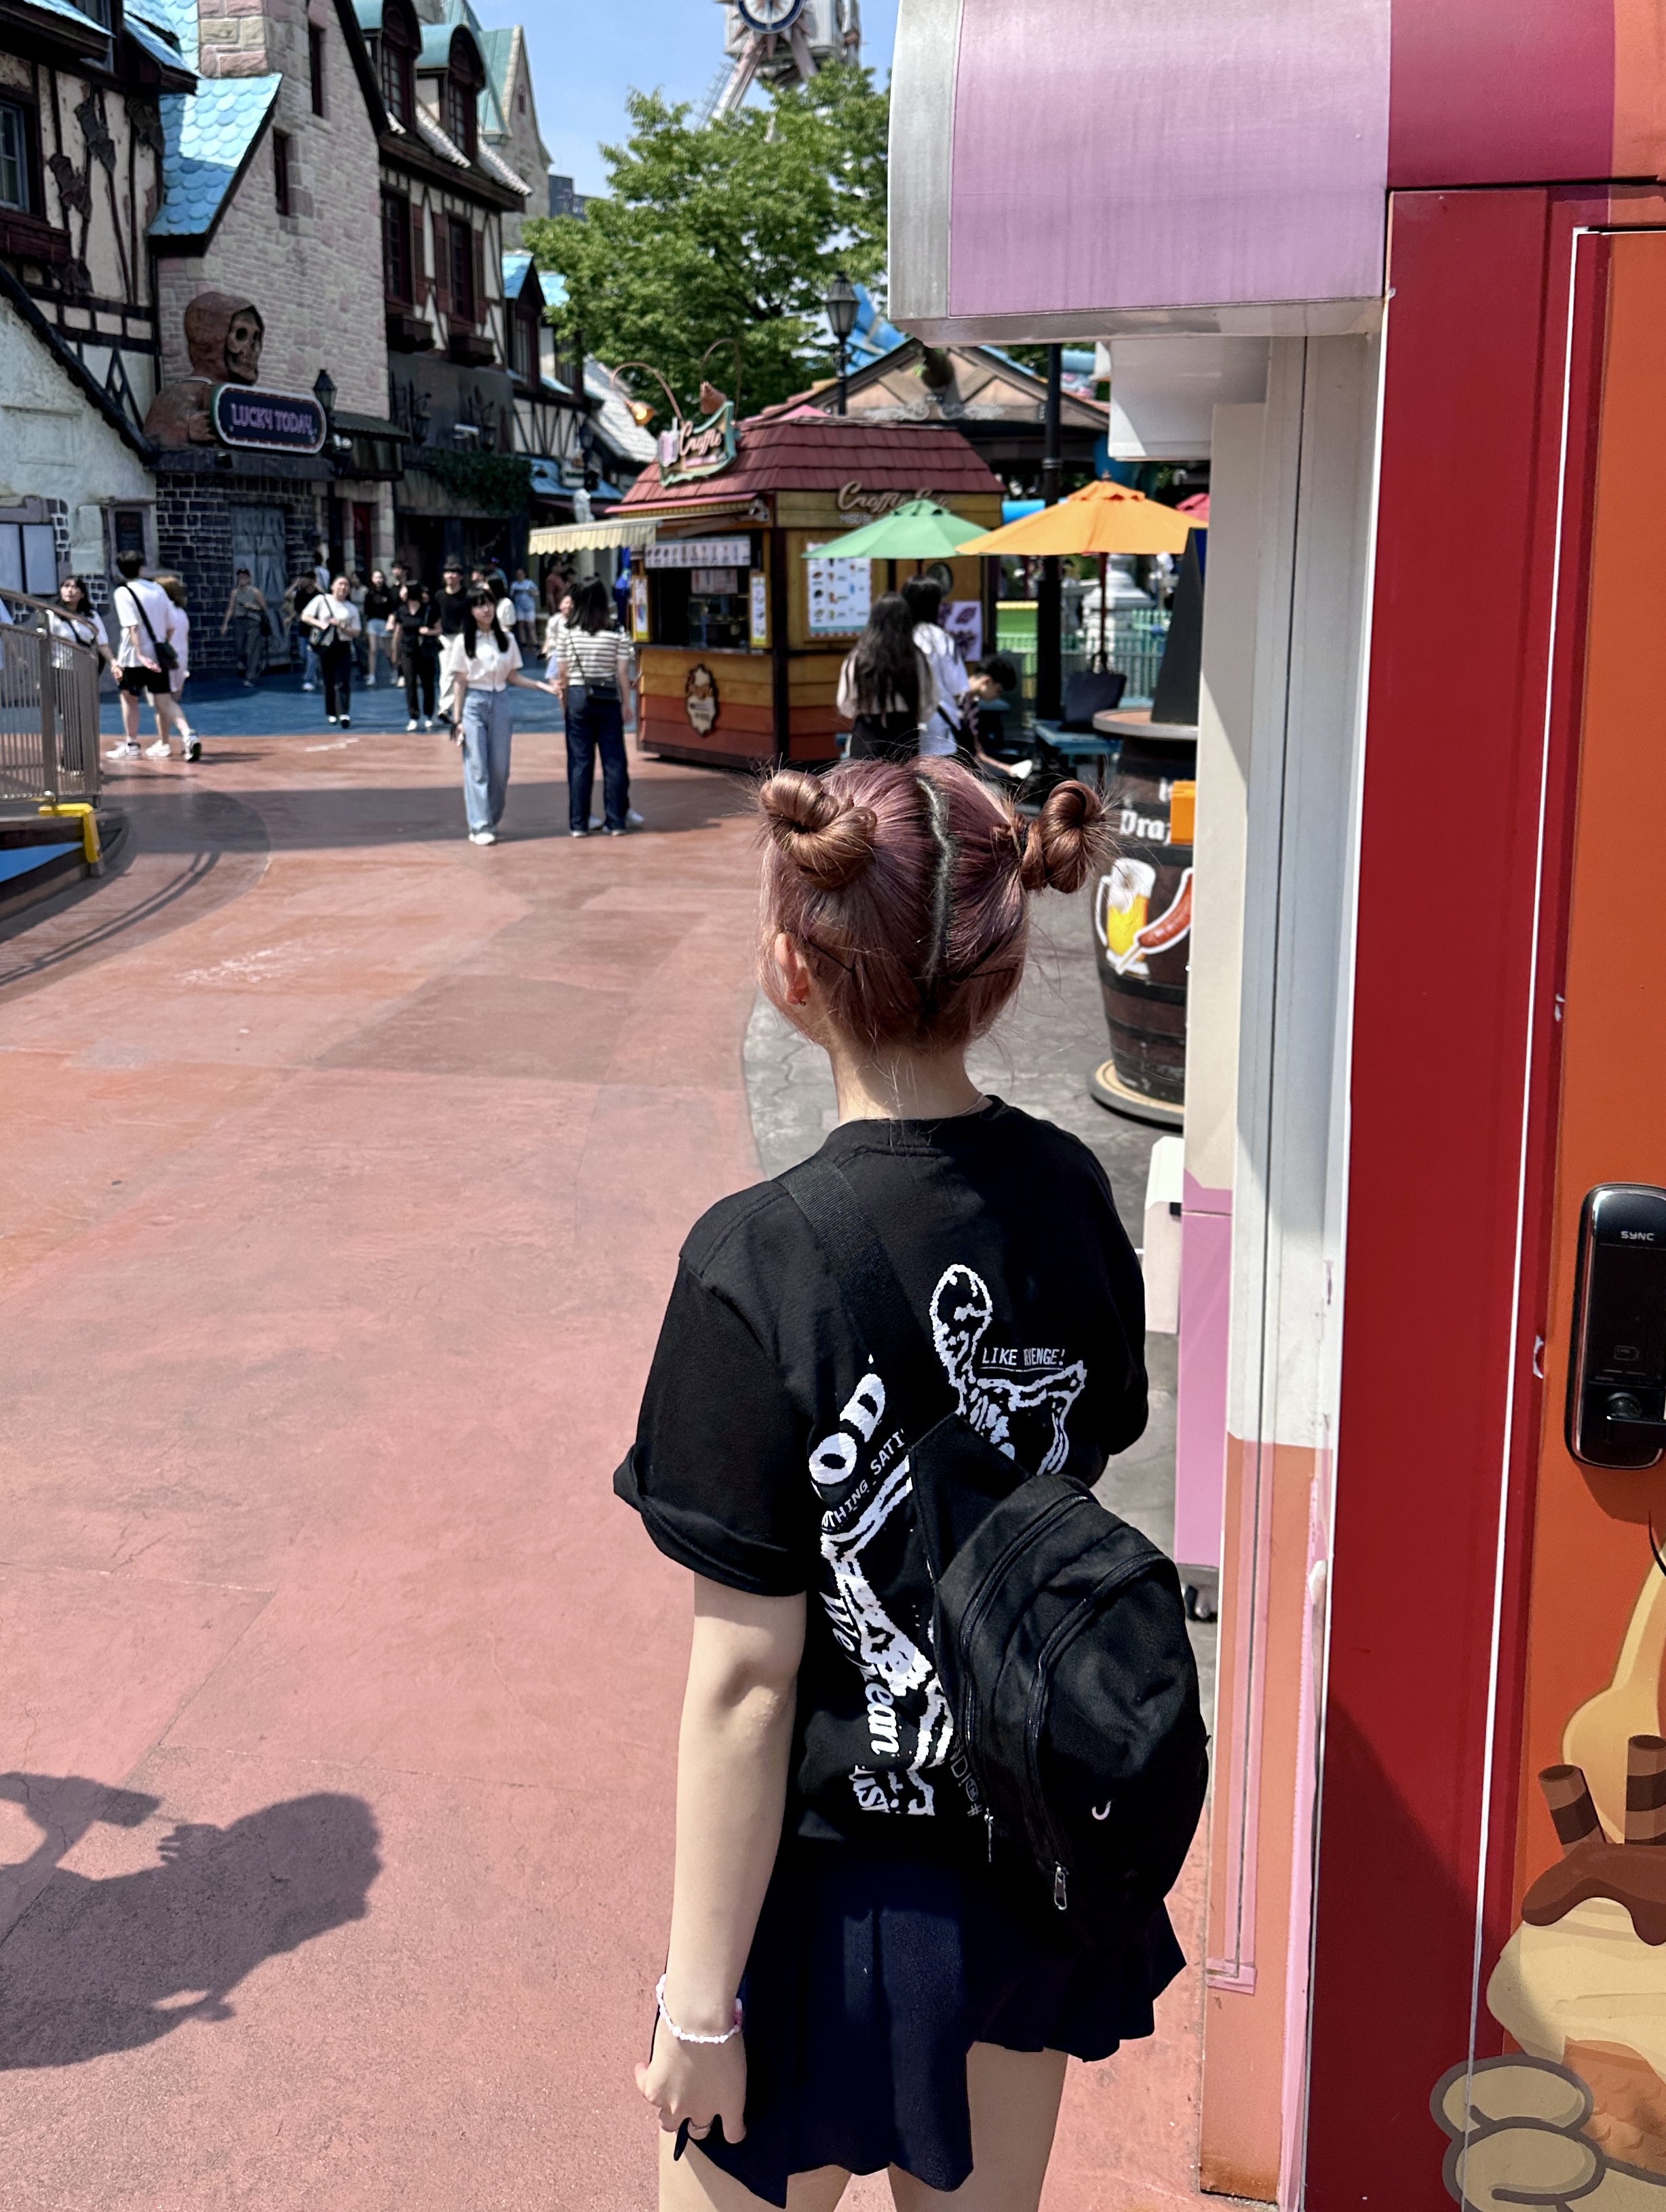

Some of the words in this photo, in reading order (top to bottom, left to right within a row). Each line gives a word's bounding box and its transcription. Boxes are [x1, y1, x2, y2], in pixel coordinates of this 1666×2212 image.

[231, 402, 273, 430] LUCKY
[274, 410, 313, 436] TODAY
[1621, 1230, 1655, 1242] SYNC
[982, 1346, 1018, 1366] LIKE
[870, 1428, 905, 1476] SATI
